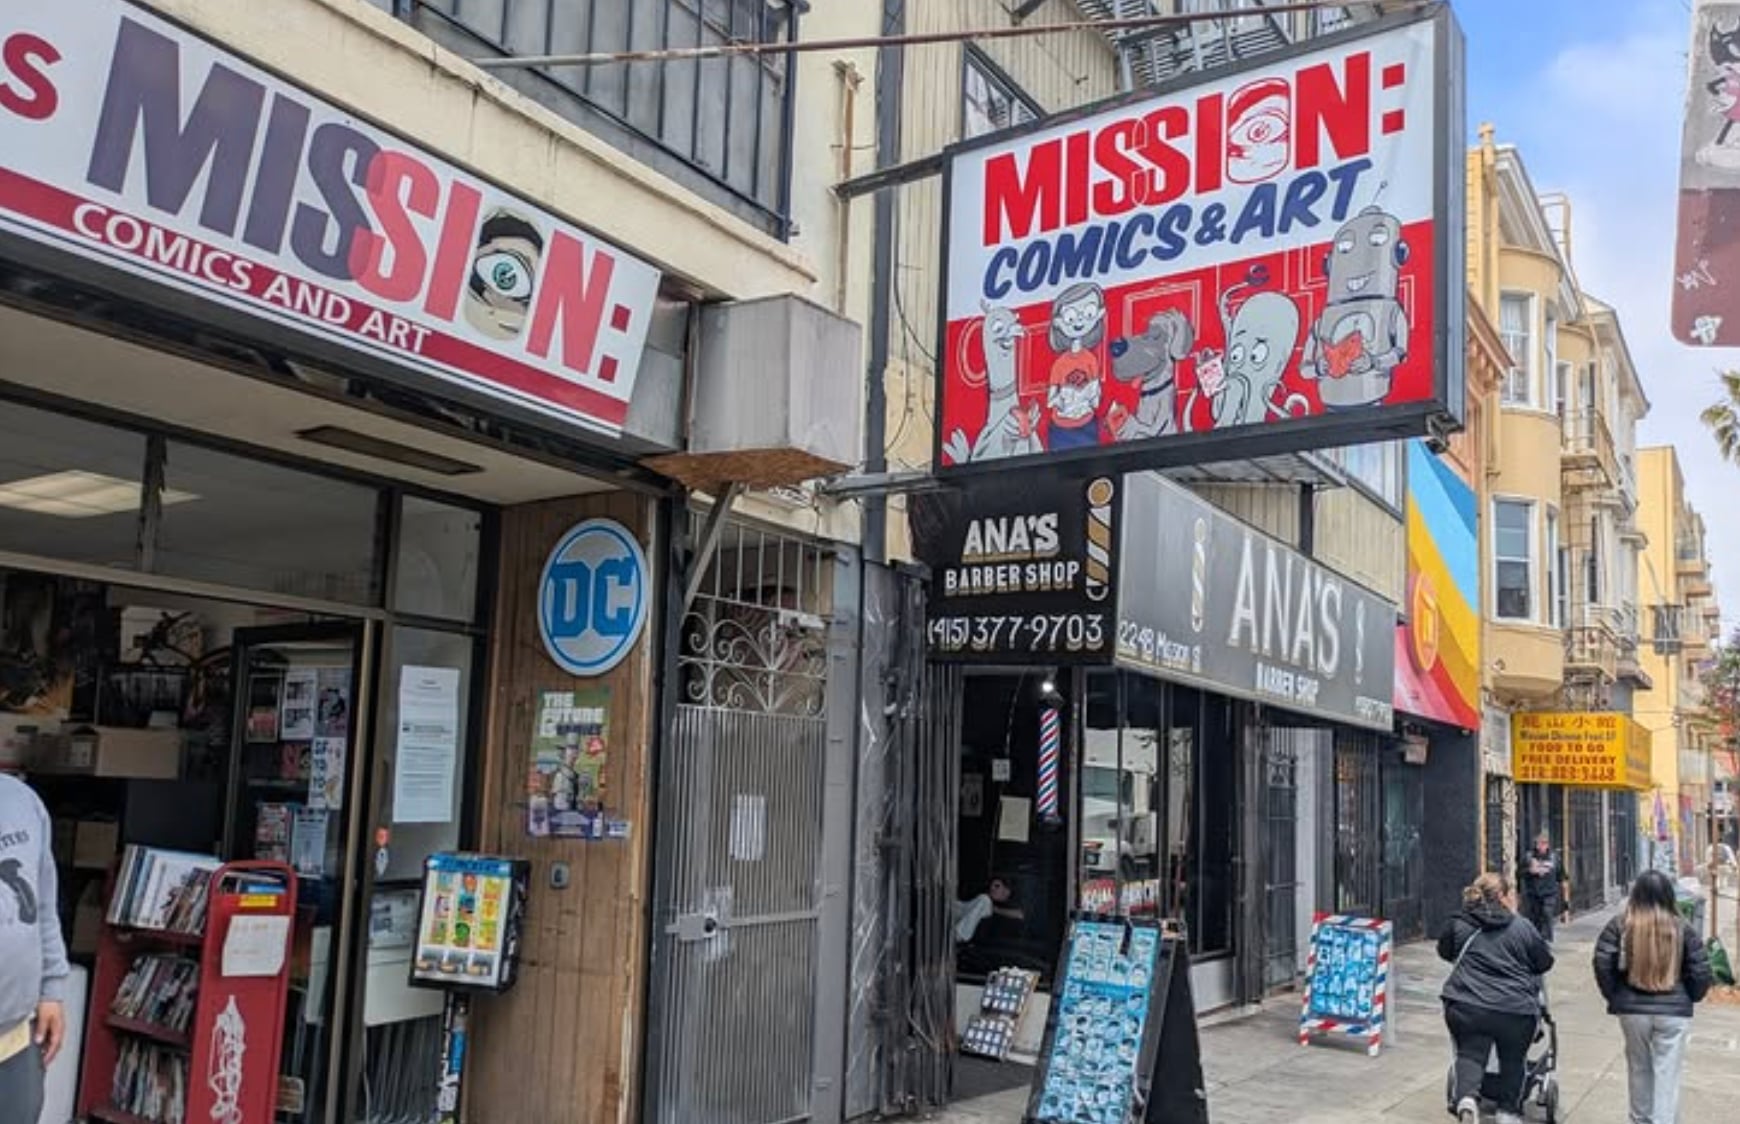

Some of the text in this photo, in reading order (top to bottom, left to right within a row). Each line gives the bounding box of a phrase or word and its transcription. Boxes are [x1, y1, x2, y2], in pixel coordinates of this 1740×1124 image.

[73, 203, 432, 354] COMICS AND ART
[961, 513, 1061, 561] ANA'S
[549, 556, 636, 637] DC
[945, 561, 1080, 593] BARBER SHOP
[1227, 530, 1343, 679] ANA'S
[1521, 754, 1551, 765] FREE
[1556, 755, 1616, 765] DELIVERY
[1529, 743, 1605, 752] FOOD TO GO
